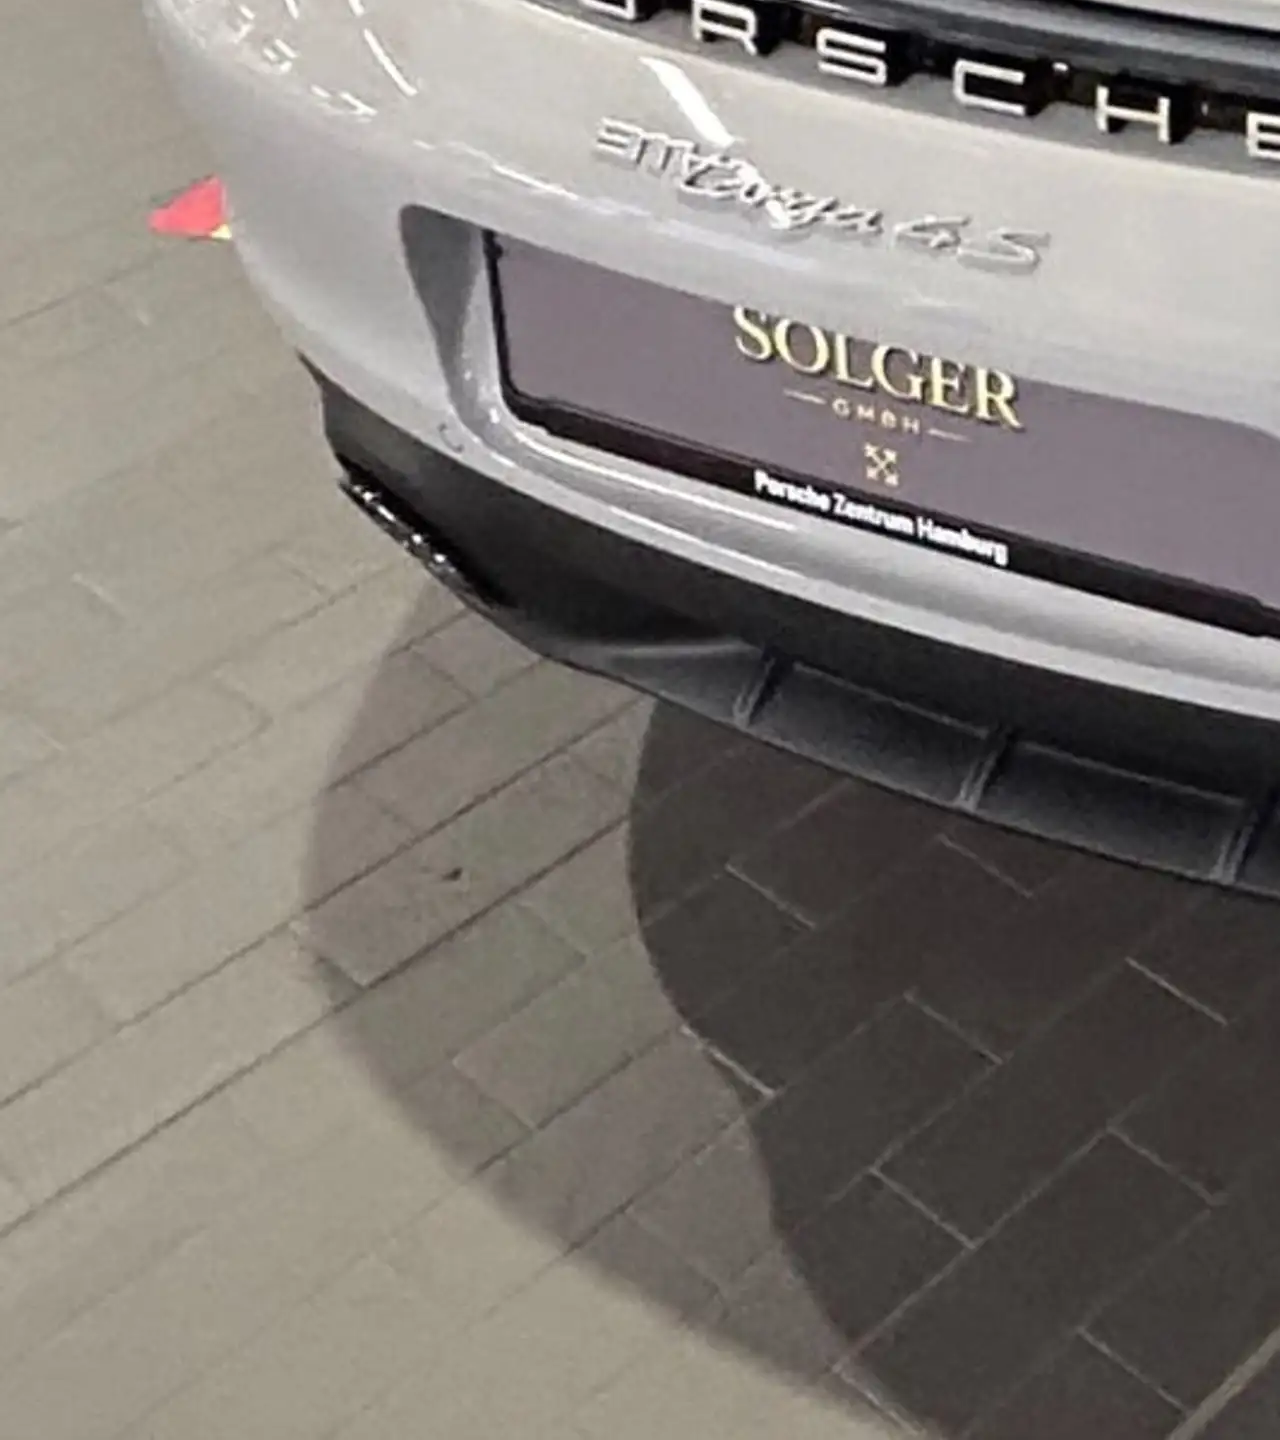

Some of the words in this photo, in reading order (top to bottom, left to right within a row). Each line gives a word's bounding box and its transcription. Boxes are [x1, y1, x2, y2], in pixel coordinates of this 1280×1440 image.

[889, 212, 1052, 268] 4S
[753, 468, 831, 511] Porsche
[833, 492, 914, 535] Zentrum
[916, 515, 1009, 567] Hamburg
